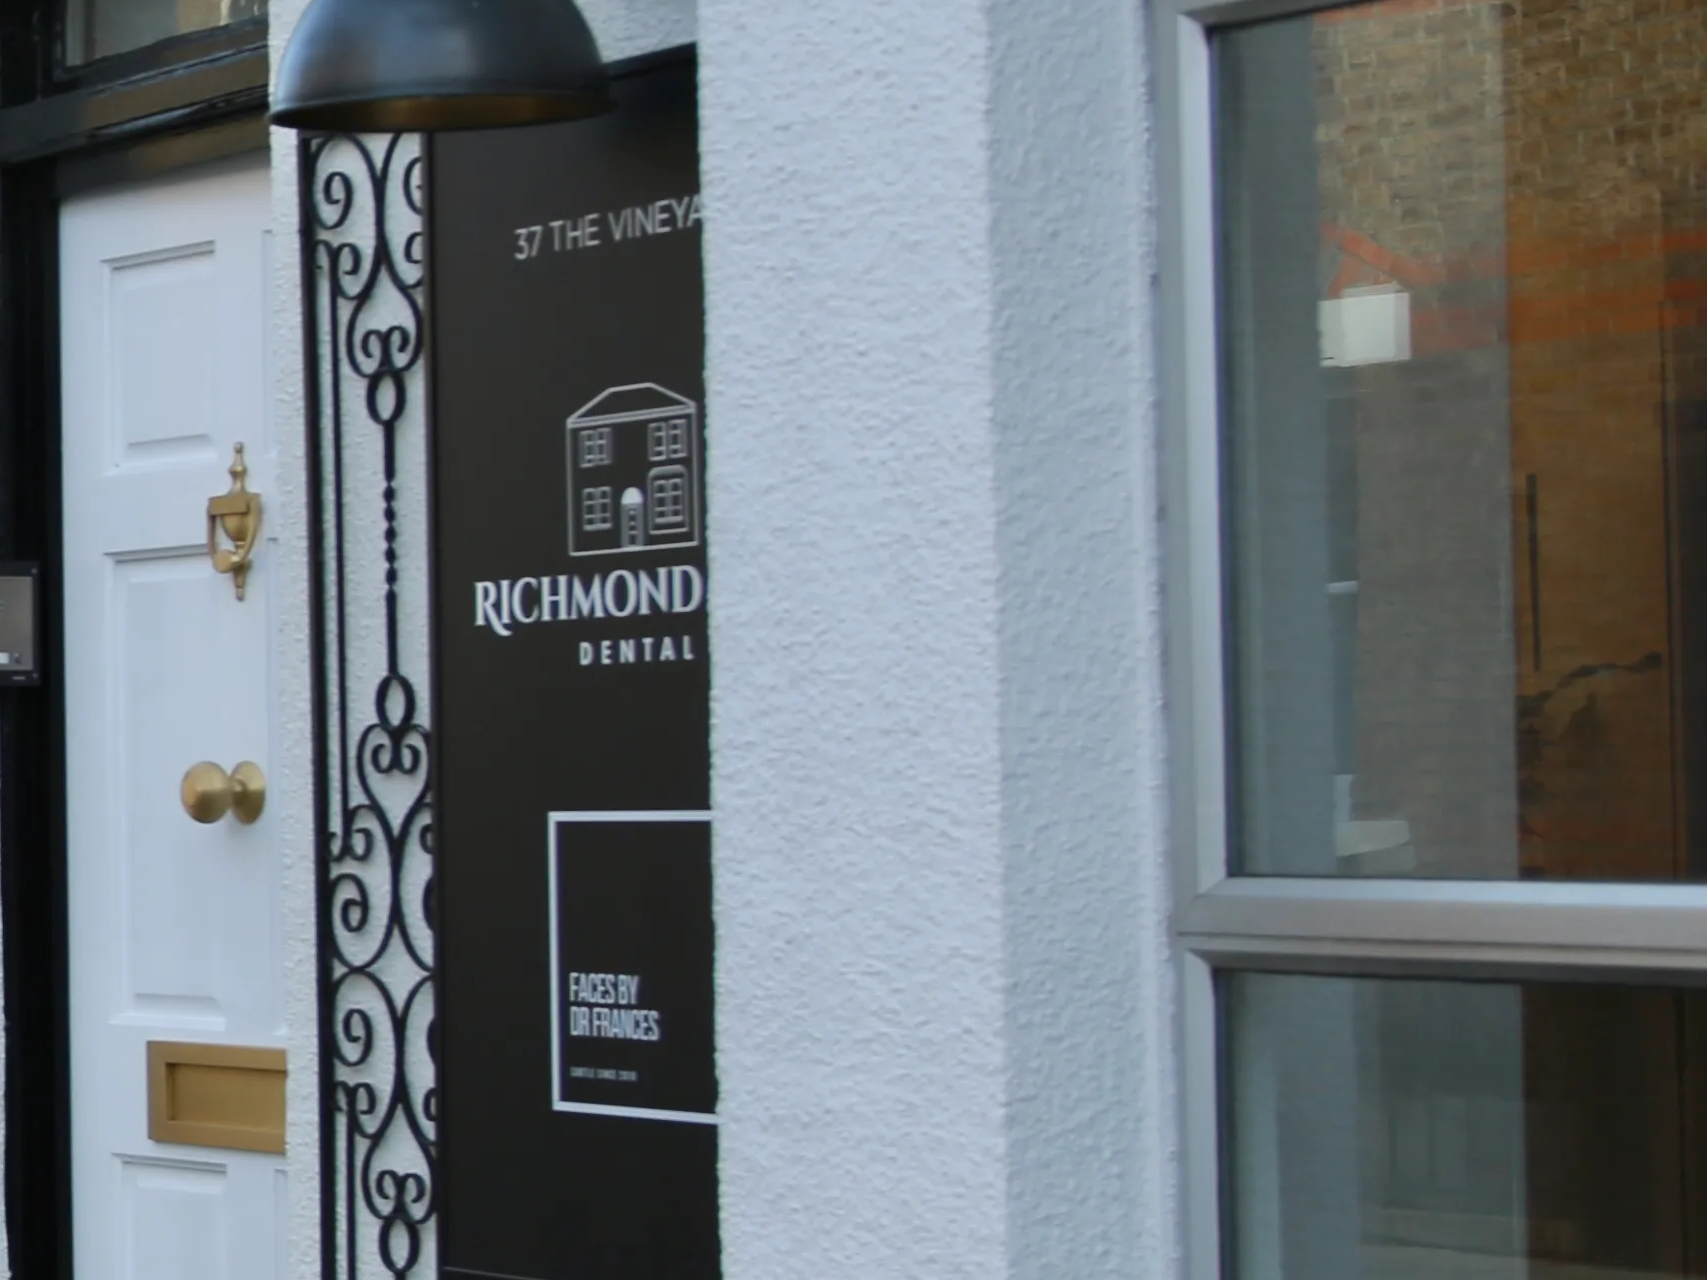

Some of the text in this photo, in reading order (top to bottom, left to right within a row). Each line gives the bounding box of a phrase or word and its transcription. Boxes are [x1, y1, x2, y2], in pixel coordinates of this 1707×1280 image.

[513, 224, 544, 261] 37
[548, 212, 603, 252] THE
[473, 564, 704, 637] RICHMOND
[578, 634, 695, 667] DENTAL
[569, 972, 640, 1005] FACES BY
[569, 1006, 661, 1041] DR FRANCES
